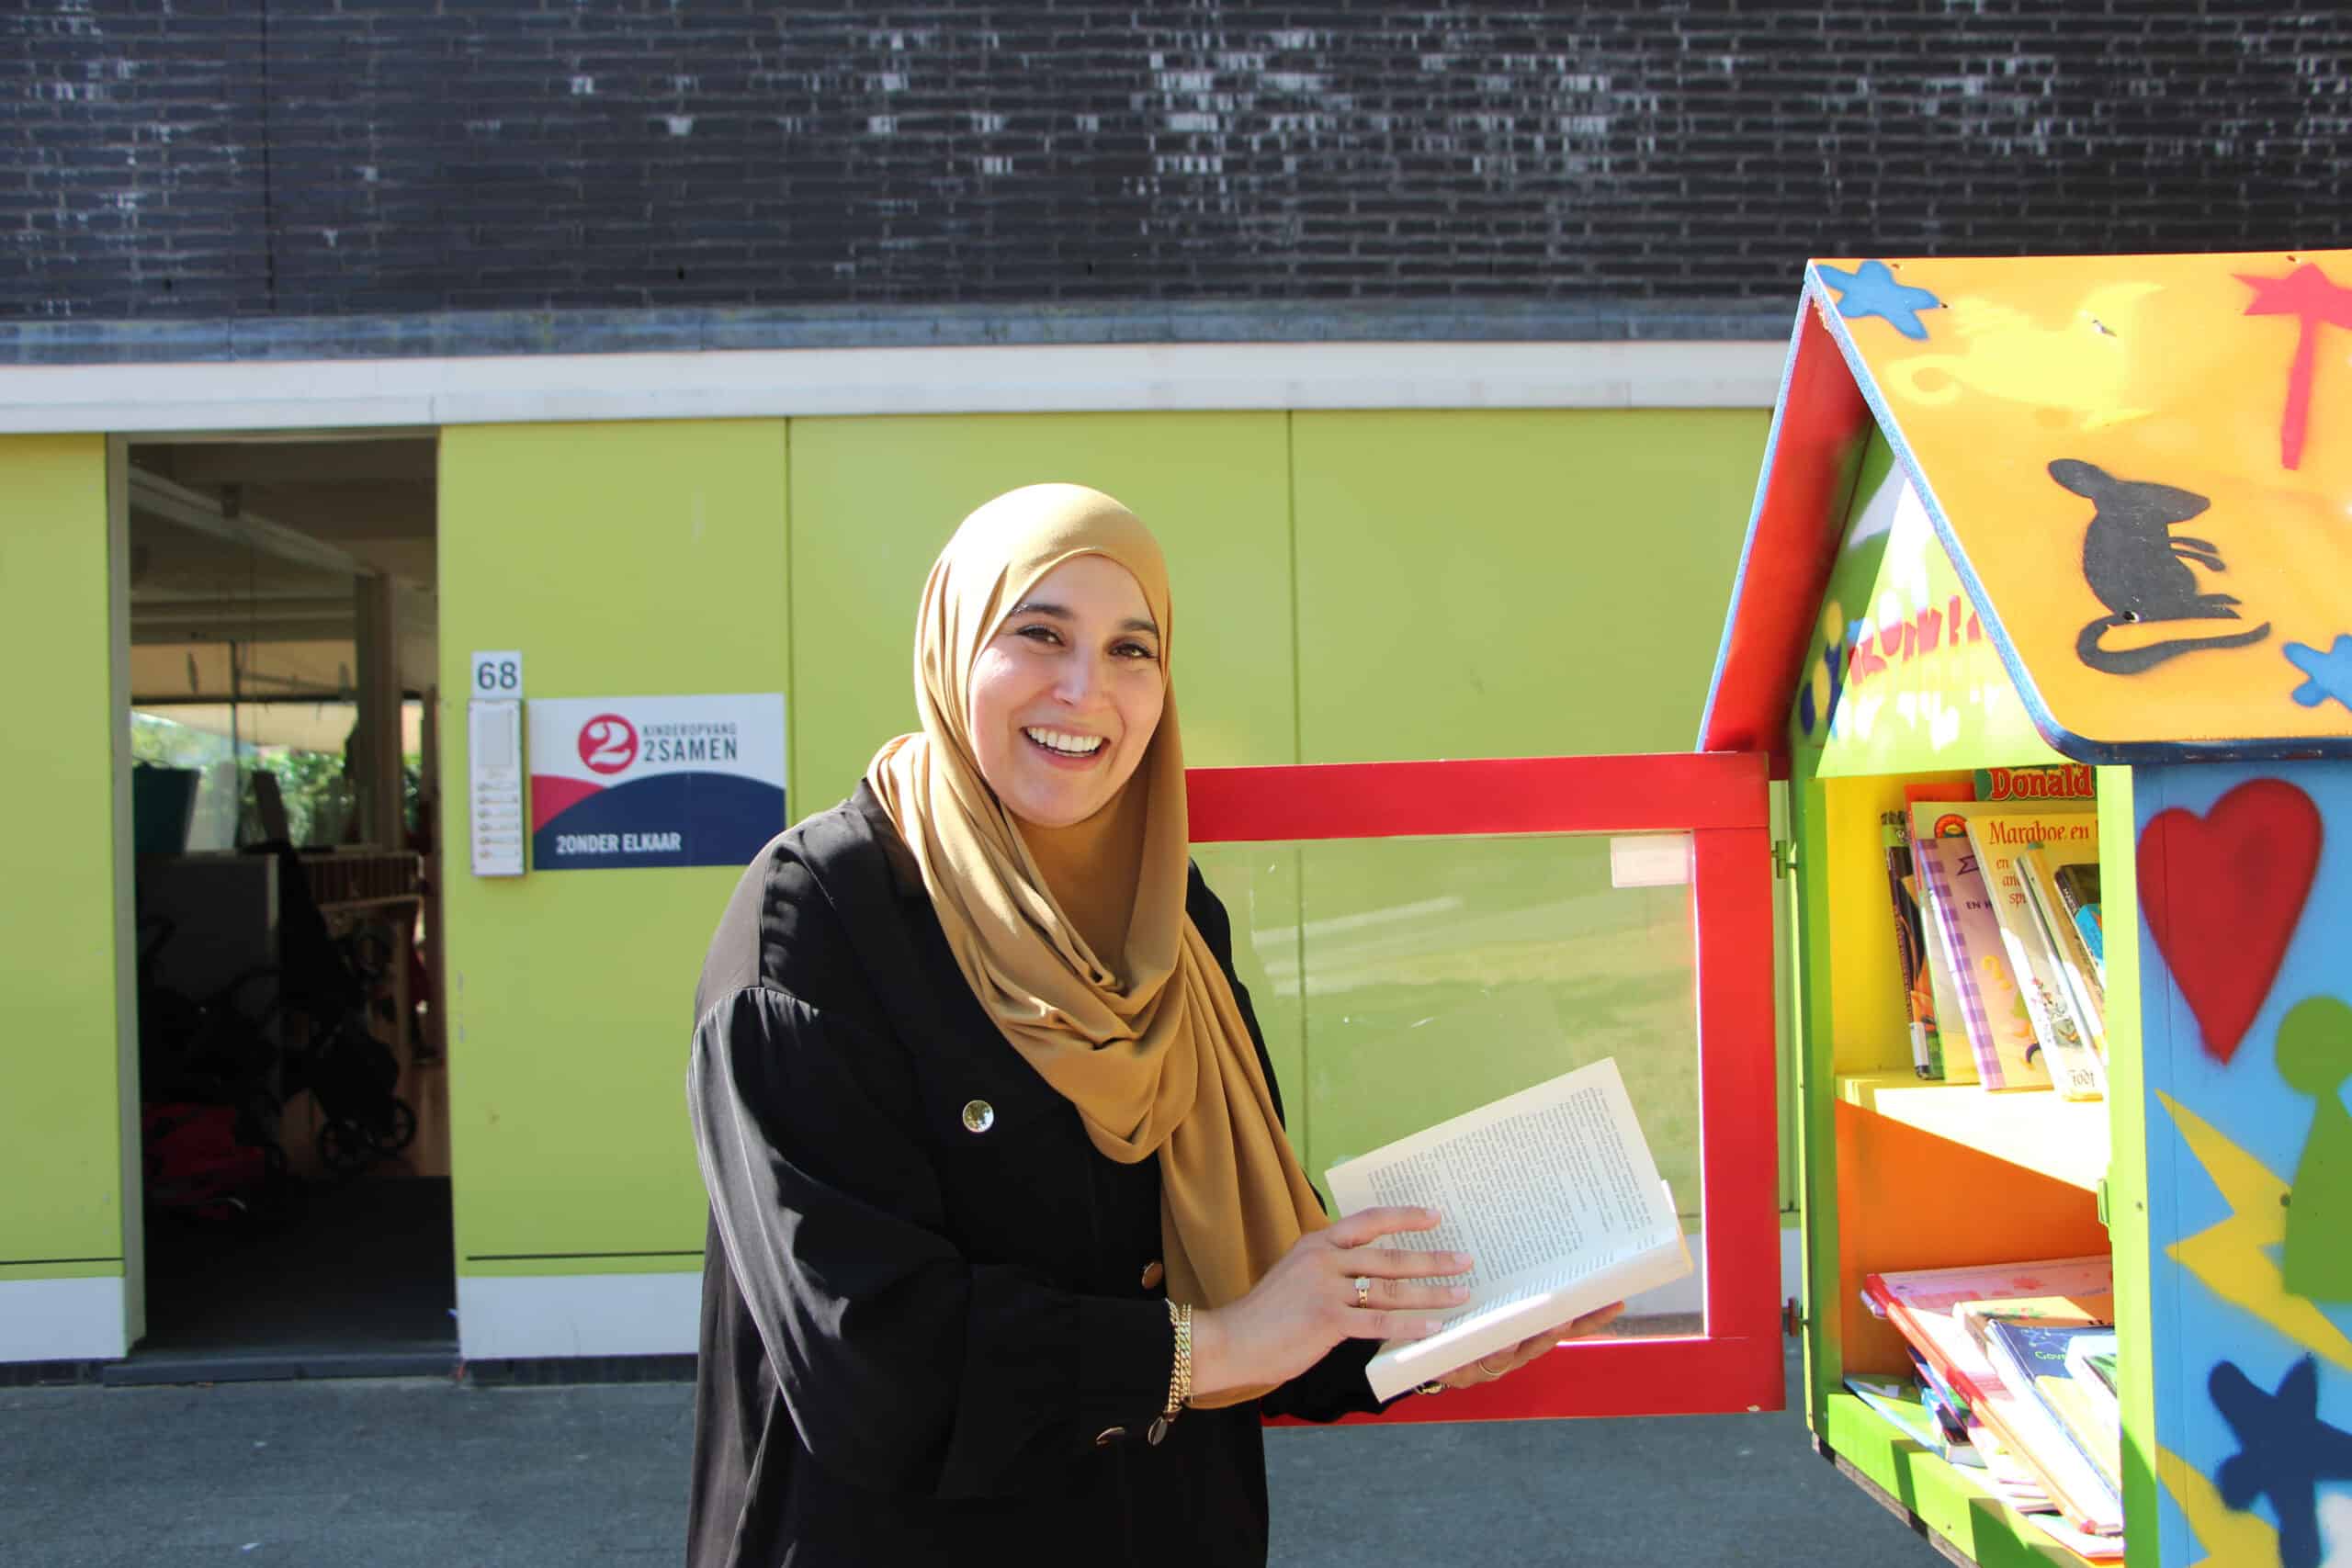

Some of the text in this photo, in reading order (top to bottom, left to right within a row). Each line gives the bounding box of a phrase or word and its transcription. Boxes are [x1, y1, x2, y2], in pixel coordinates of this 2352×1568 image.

[478, 661, 517, 690] 68
[644, 738, 738, 761] 2SAMEN
[1988, 763, 2095, 800] Donald
[622, 831, 682, 852] ELKAAR
[1989, 820, 2090, 844] Maraboe en
